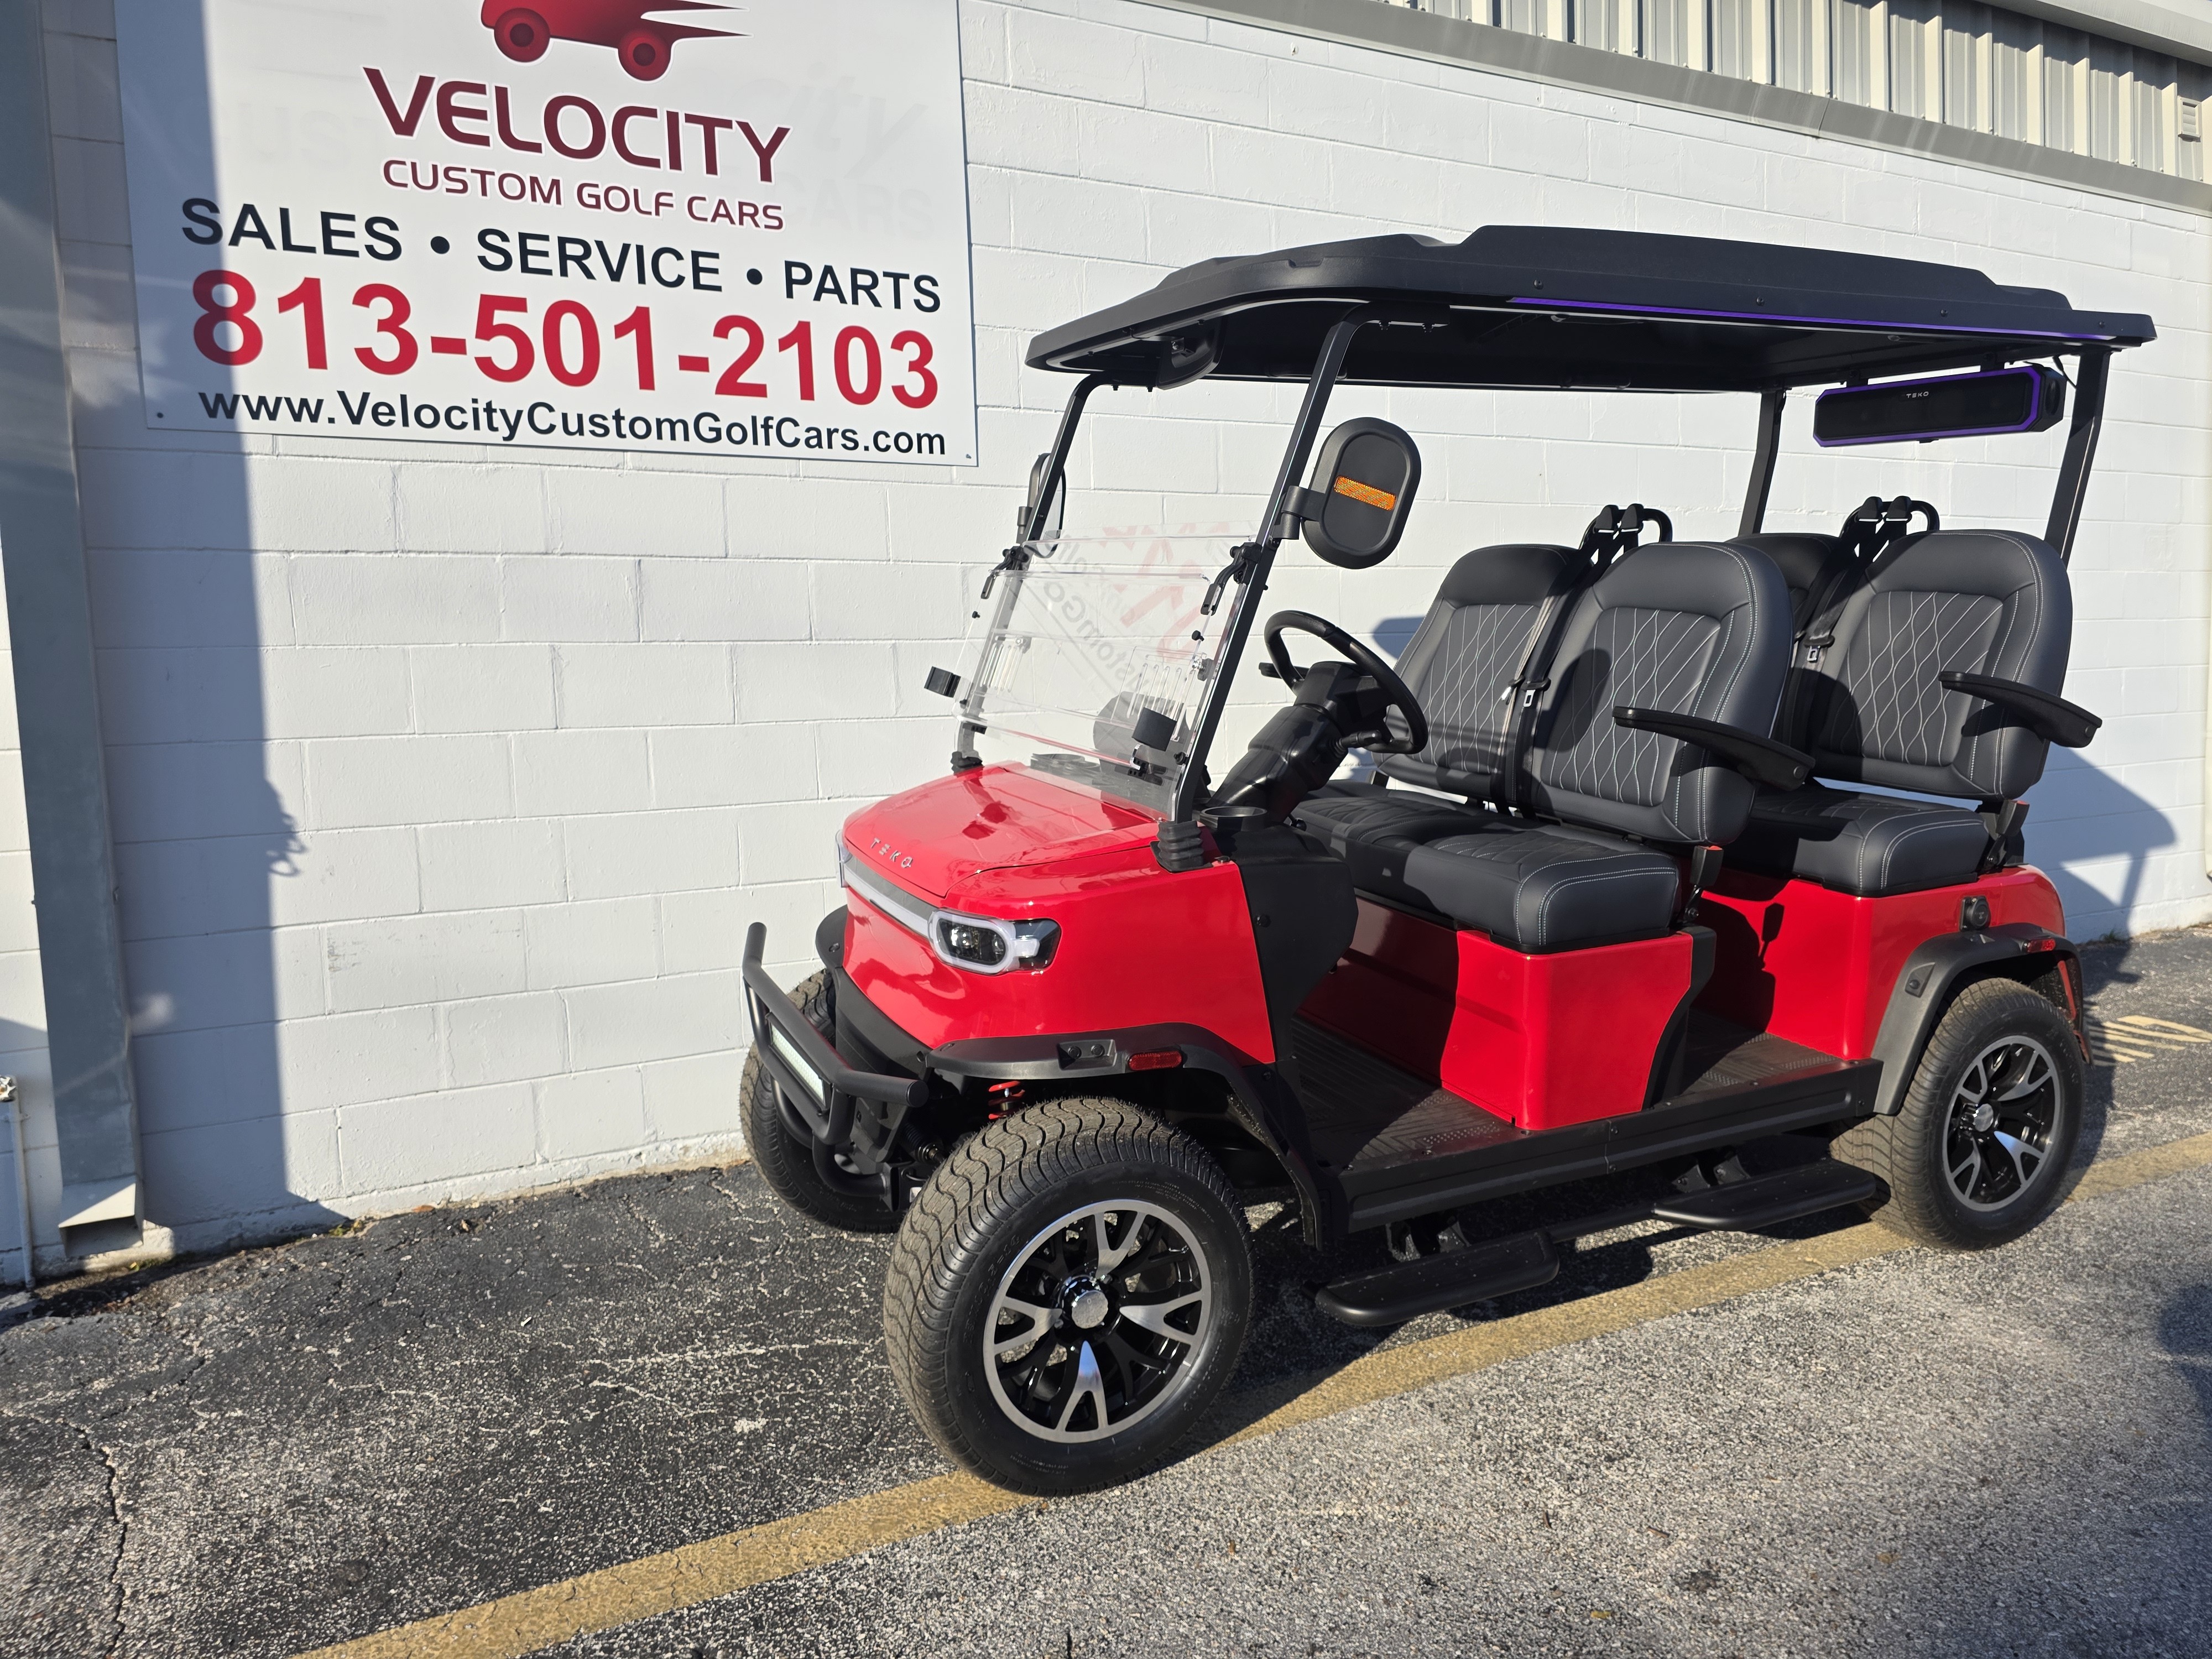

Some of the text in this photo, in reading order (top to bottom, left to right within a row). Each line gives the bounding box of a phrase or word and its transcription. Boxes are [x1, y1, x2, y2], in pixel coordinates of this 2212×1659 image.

[363, 67, 790, 182] VELOCITY
[383, 159, 783, 229] CUSTOM GOLF CARS
[181, 197, 940, 312] SALES SERVICE PARTS
[192, 268, 938, 409] 813-501-2103
[198, 390, 945, 455] www.VelocityCustomGolfCars.com
[870, 837, 913, 868] TEKO
